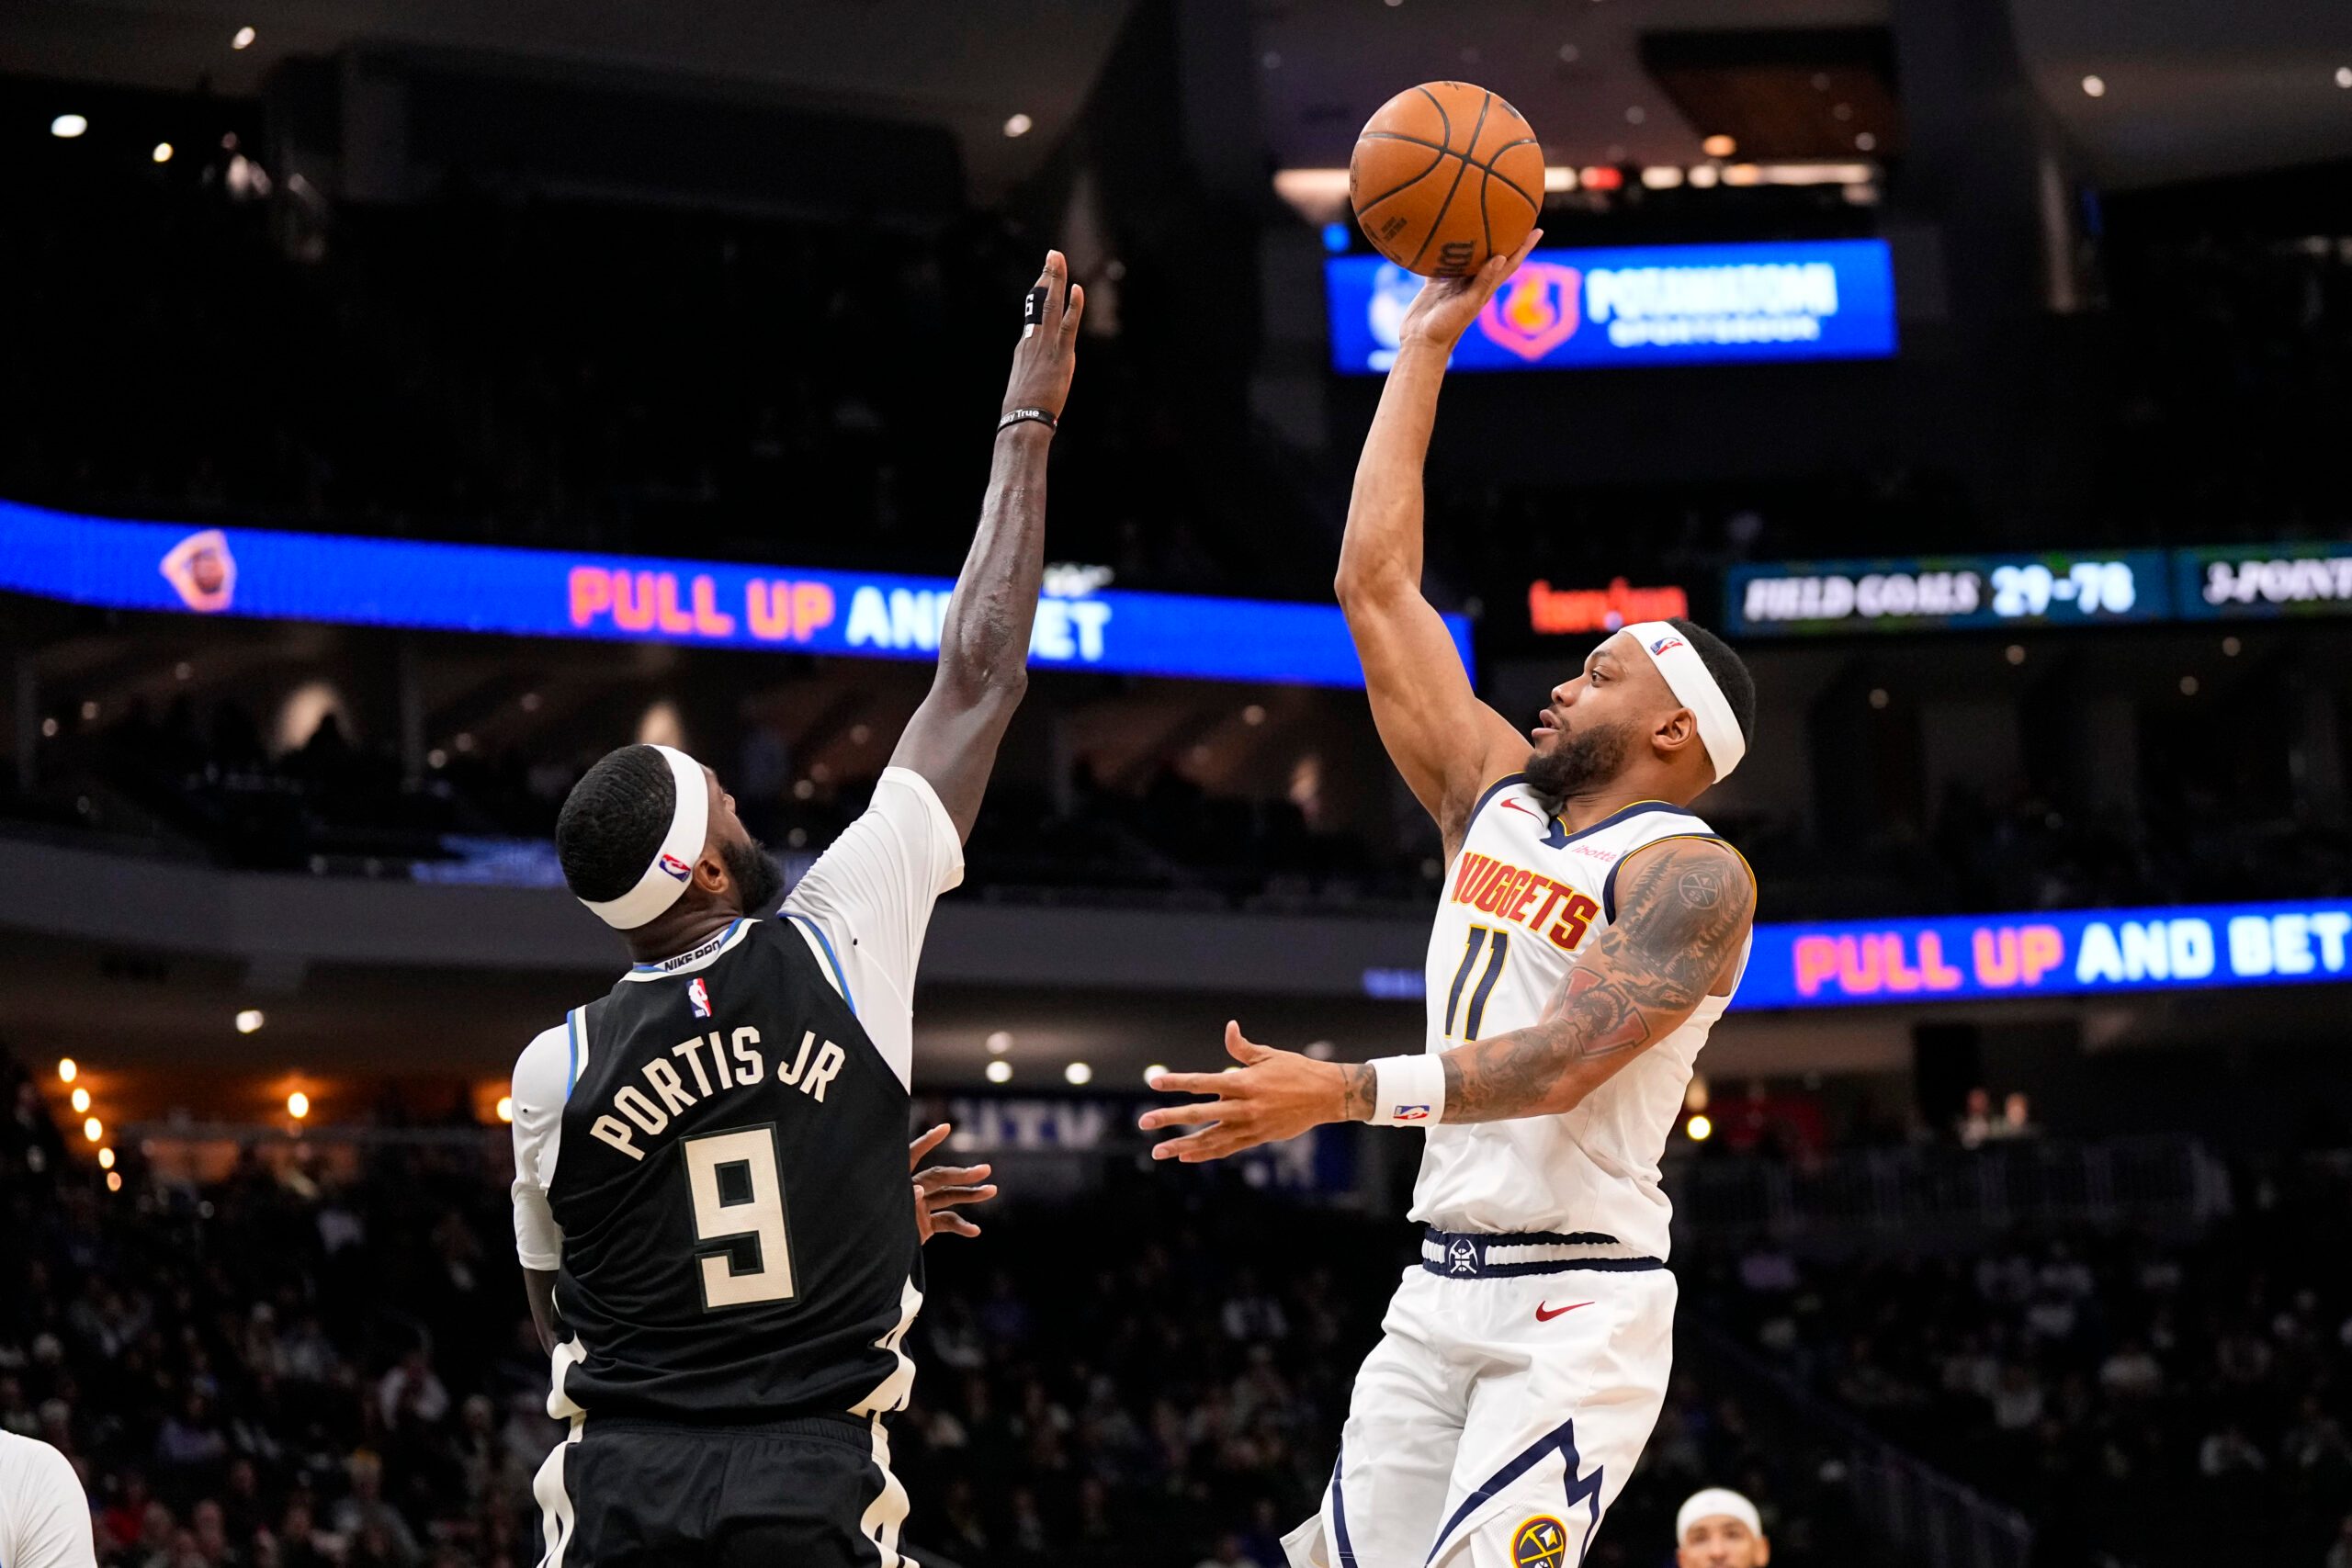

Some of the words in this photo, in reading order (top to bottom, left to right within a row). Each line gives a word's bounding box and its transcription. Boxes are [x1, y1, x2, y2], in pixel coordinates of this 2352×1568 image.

[1015, 409, 1039, 418] True
[570, 564, 735, 637] PULL
[745, 578, 835, 643] UP
[1029, 598, 1112, 660] ET
[1744, 575, 1855, 621] FIELD
[1856, 571, 1981, 617] GOALS
[1571, 844, 1617, 863] ibotta
[1451, 852, 1601, 951] NUGGETS
[664, 953, 693, 972] NIKE
[694, 940, 721, 959] PRO
[1443, 923, 1510, 1043] 11
[1794, 931, 1963, 997] PULL
[1973, 924, 2064, 987] UP
[2075, 918, 2215, 985] AND
[2228, 911, 2351, 976] BET
[589, 1026, 764, 1161] PORTIS
[777, 1030, 846, 1103] JR
[681, 1123, 797, 1312] 9
